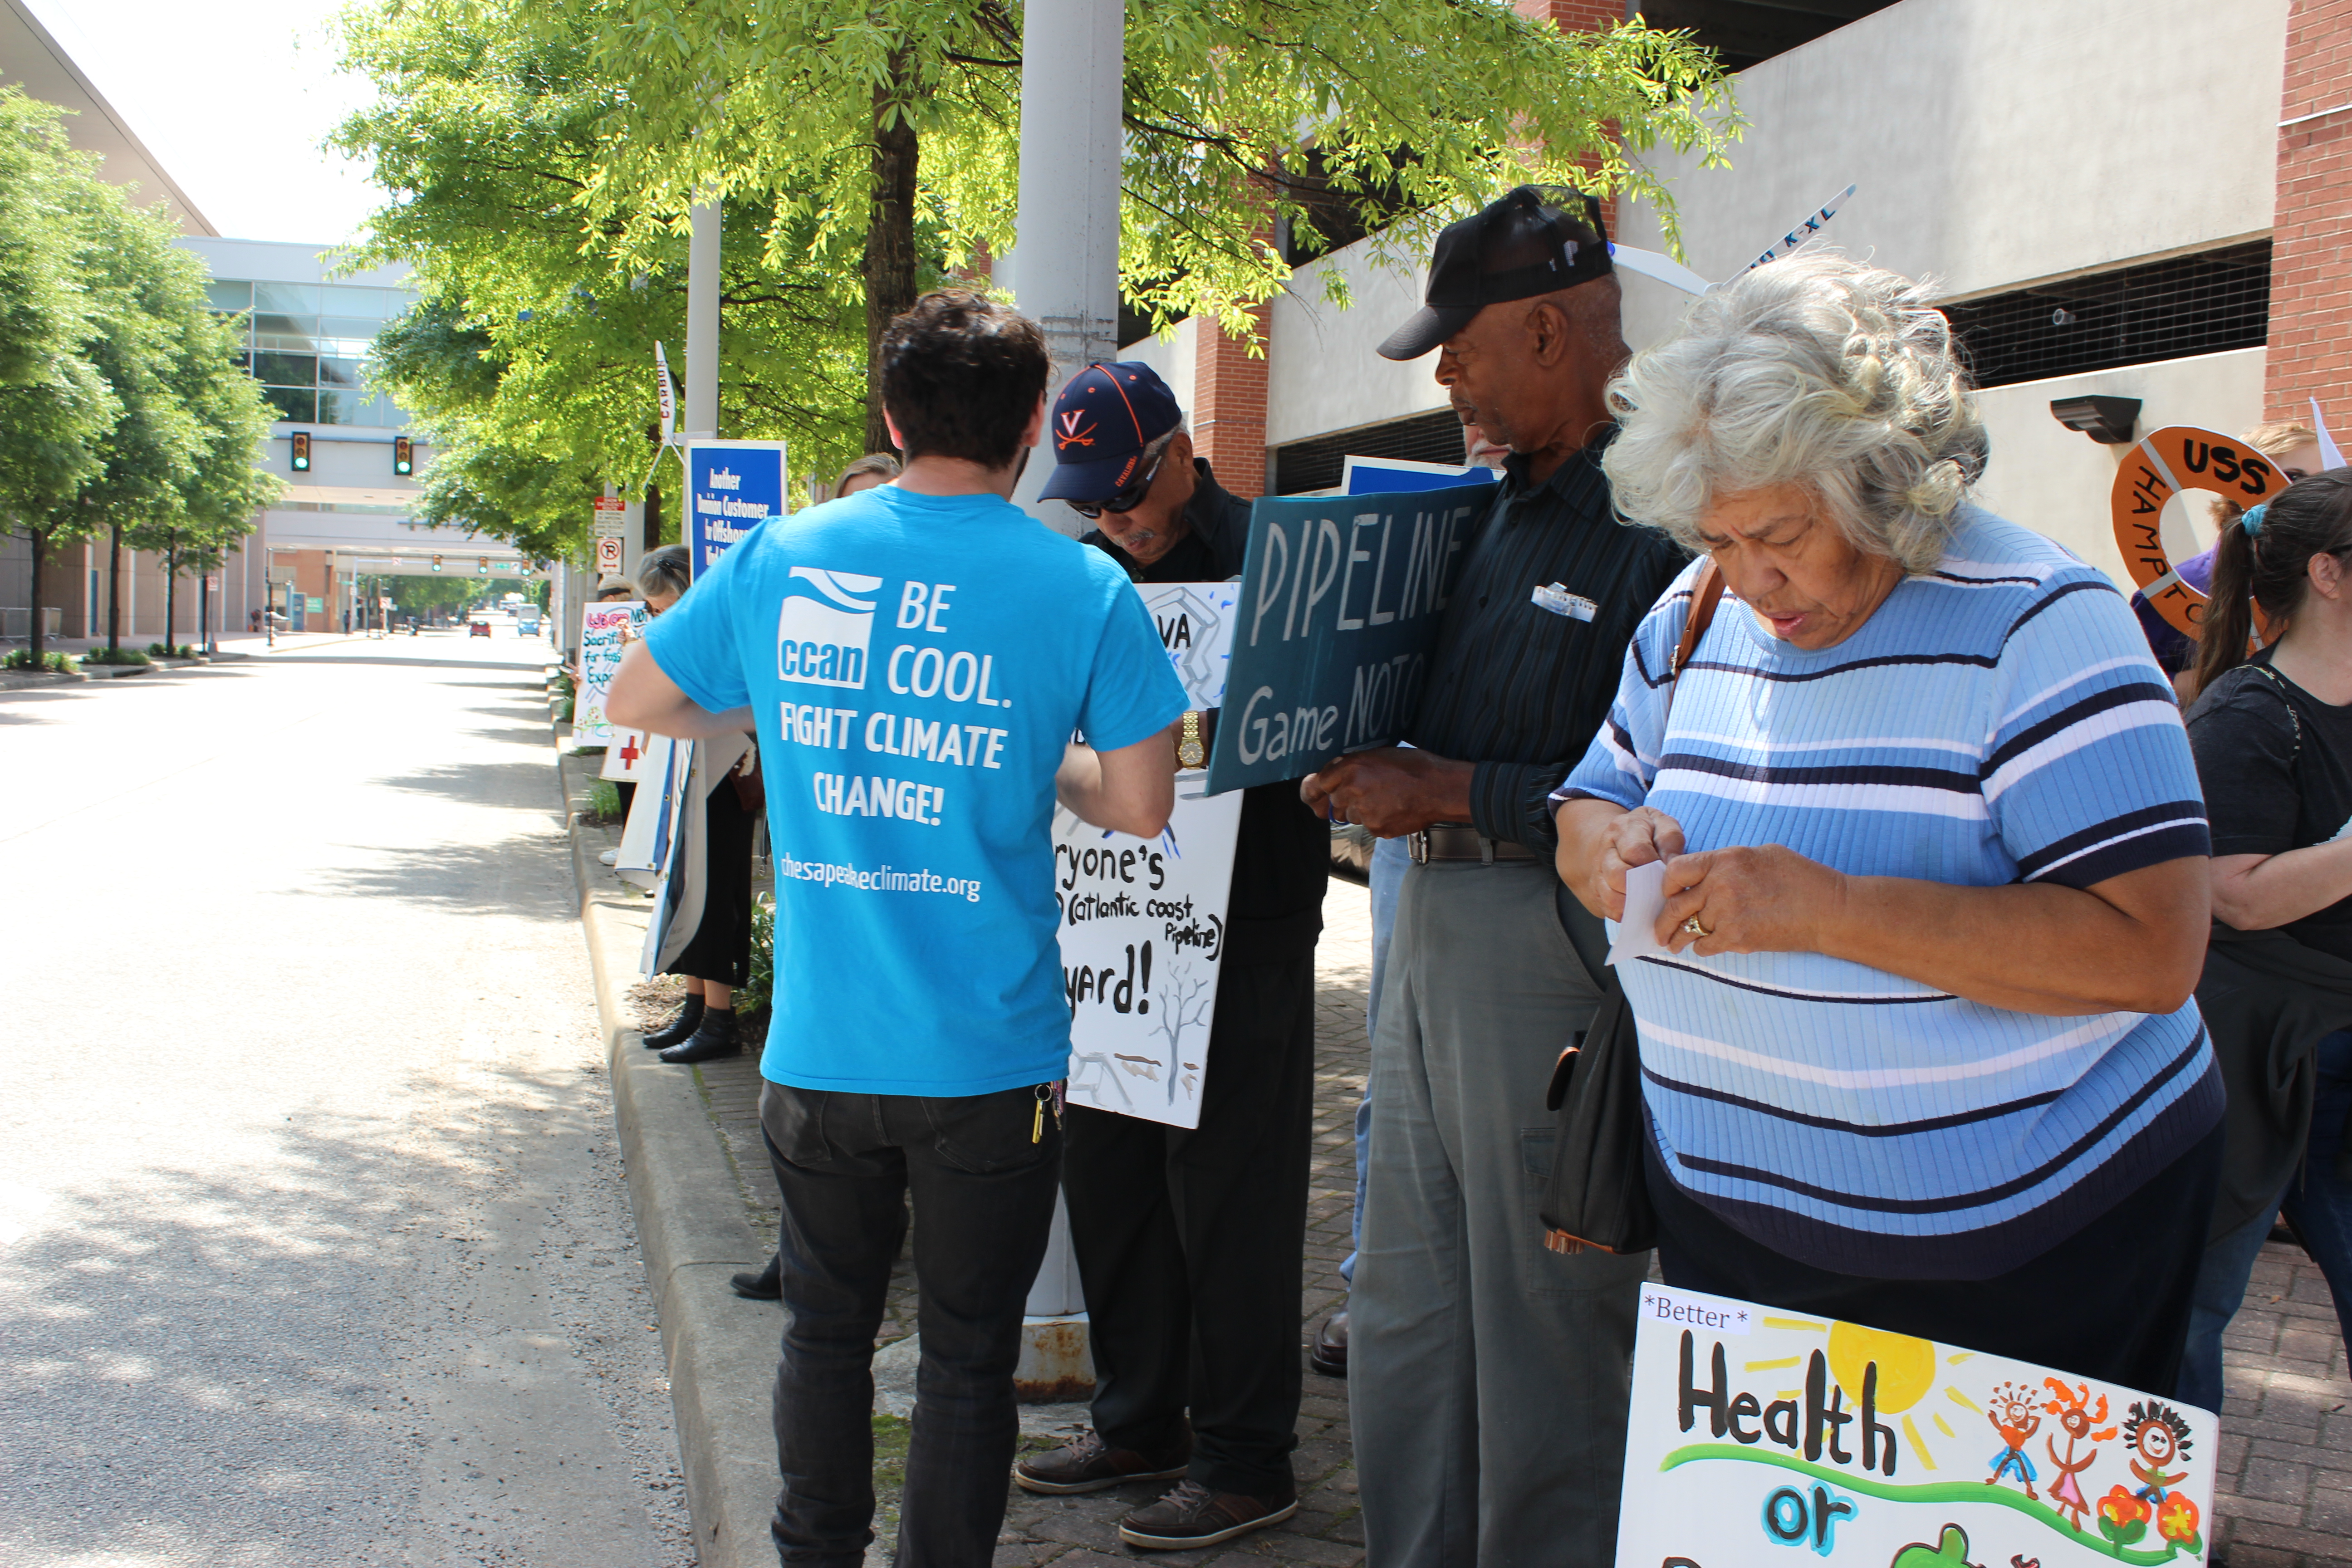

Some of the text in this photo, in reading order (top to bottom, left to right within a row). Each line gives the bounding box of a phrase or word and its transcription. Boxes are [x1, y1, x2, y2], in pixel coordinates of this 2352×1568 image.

[656, 360, 670, 418] CARBON
[709, 466, 742, 490] Another
[1114, 455, 1138, 487] CAVALIERS
[2183, 438, 2270, 495] USS
[712, 519, 750, 544] Offshor
[722, 495, 769, 519] Customer
[896, 580, 957, 633] BE
[780, 639, 864, 684] ccan
[887, 644, 1013, 708] COOL.
[780, 701, 1009, 769] FIGHT CLIMATE
[1238, 685, 1339, 766] Game
[813, 771, 945, 827] CHANGE!
[780, 852, 981, 903] chesapeakeclimate.org
[1147, 893, 1194, 921] coast
[1677, 1328, 1897, 1477] Health
[1766, 1485, 1852, 1550] or
